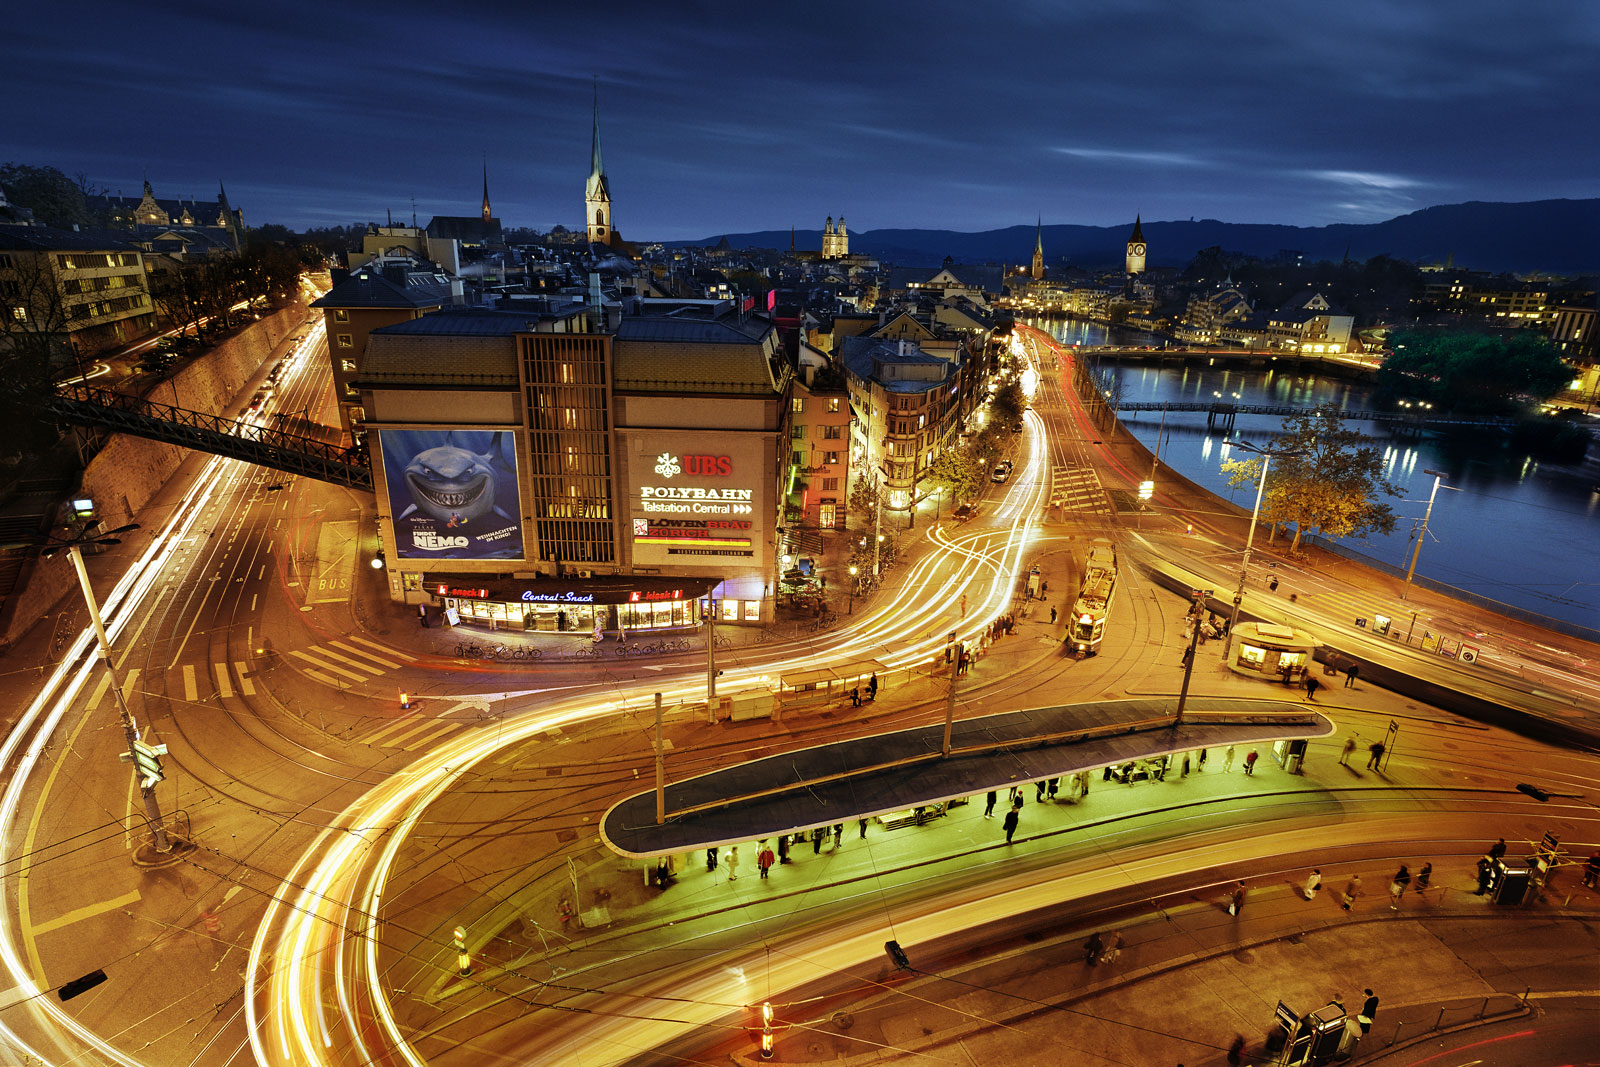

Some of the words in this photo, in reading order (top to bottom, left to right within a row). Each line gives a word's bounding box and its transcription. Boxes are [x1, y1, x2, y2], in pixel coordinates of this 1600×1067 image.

[683, 455, 732, 475] UBS
[640, 486, 753, 500] POLYBAHN
[641, 501, 690, 513] Talstation
[692, 503, 730, 514] Central
[648, 518, 752, 530] LÖWENBRÄU
[475, 525, 518, 541] WEIHNACHTEN
[413, 536, 469, 548] NEMO
[318, 578, 347, 591] BUS
[521, 590, 594, 602] Central-Snack
